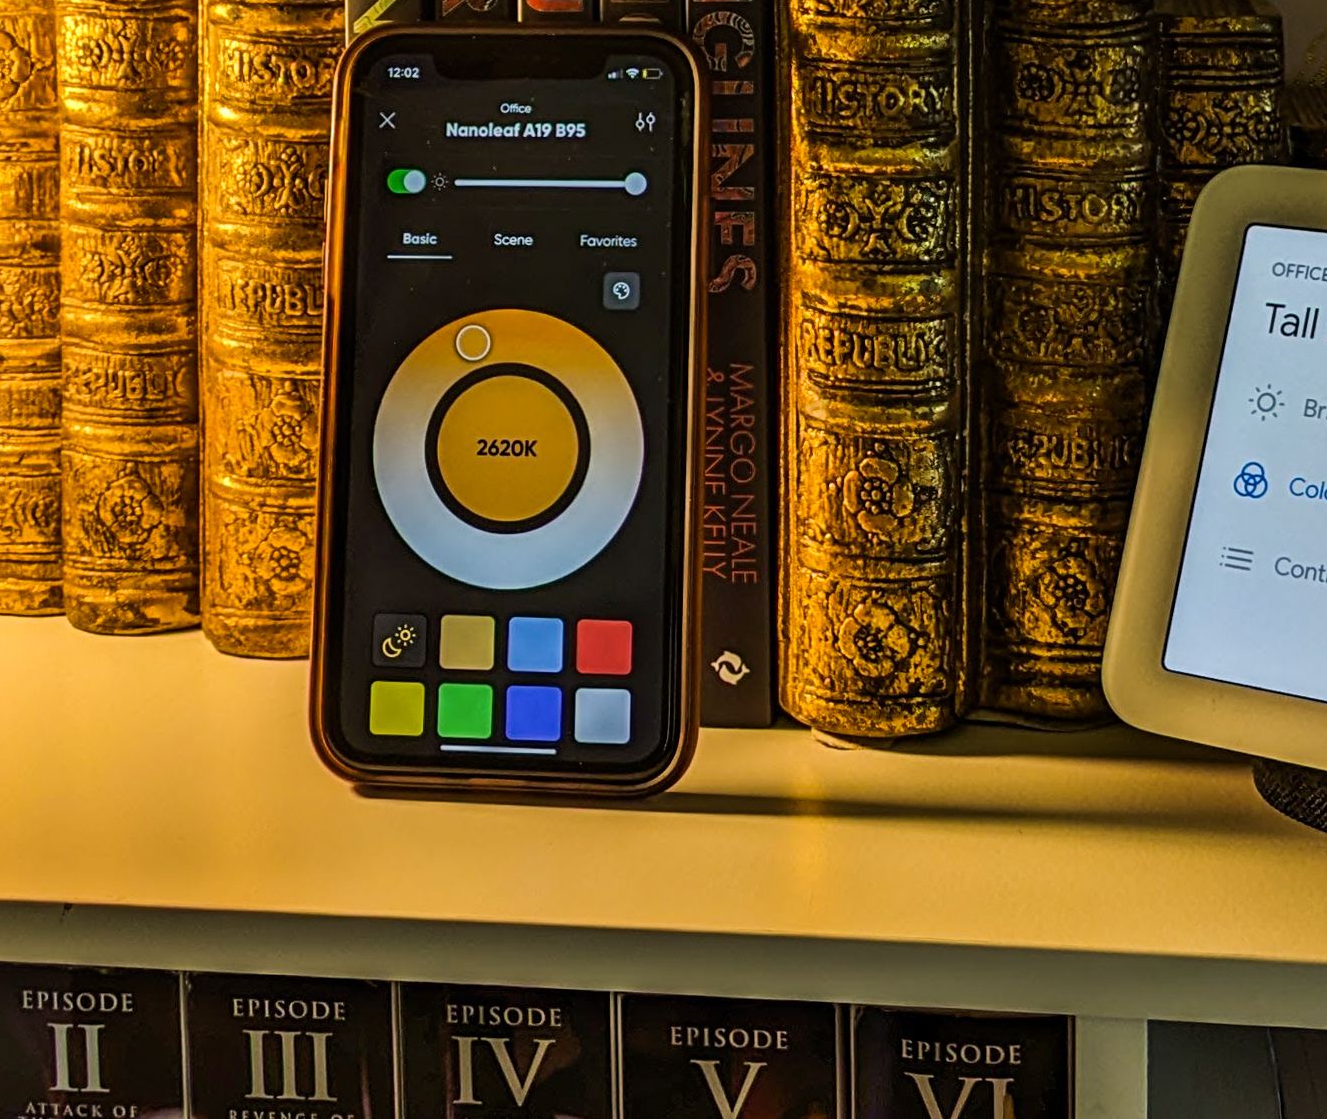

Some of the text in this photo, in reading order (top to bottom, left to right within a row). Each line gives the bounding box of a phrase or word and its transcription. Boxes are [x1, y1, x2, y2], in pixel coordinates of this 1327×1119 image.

[387, 66, 420, 79] 12:02
[500, 102, 532, 114] Office
[446, 122, 587, 138] Nanoleaf A19 B95
[402, 232, 438, 245] Basic
[494, 233, 534, 246] Scene
[579, 234, 638, 248] Favorites
[1265, 302, 1320, 340] Tall
[706, 367, 725, 385] &
[476, 438, 538, 458] 2620K
[729, 363, 757, 585] MARGO NEALE
[22, 989, 134, 1013] EPISODE
[232, 997, 347, 1021] EPISODE
[446, 1003, 563, 1027] EPISODE
[670, 1025, 790, 1051] EPISODE
[46, 1022, 111, 1093] II
[900, 1038, 1023, 1065] EPISODE
[241, 1028, 339, 1103] III
[451, 1035, 557, 1107] IV
[689, 1059, 768, 1119] V
[904, 1071, 1015, 1119] VI
[25, 1101, 139, 1119] ATTACK OF
